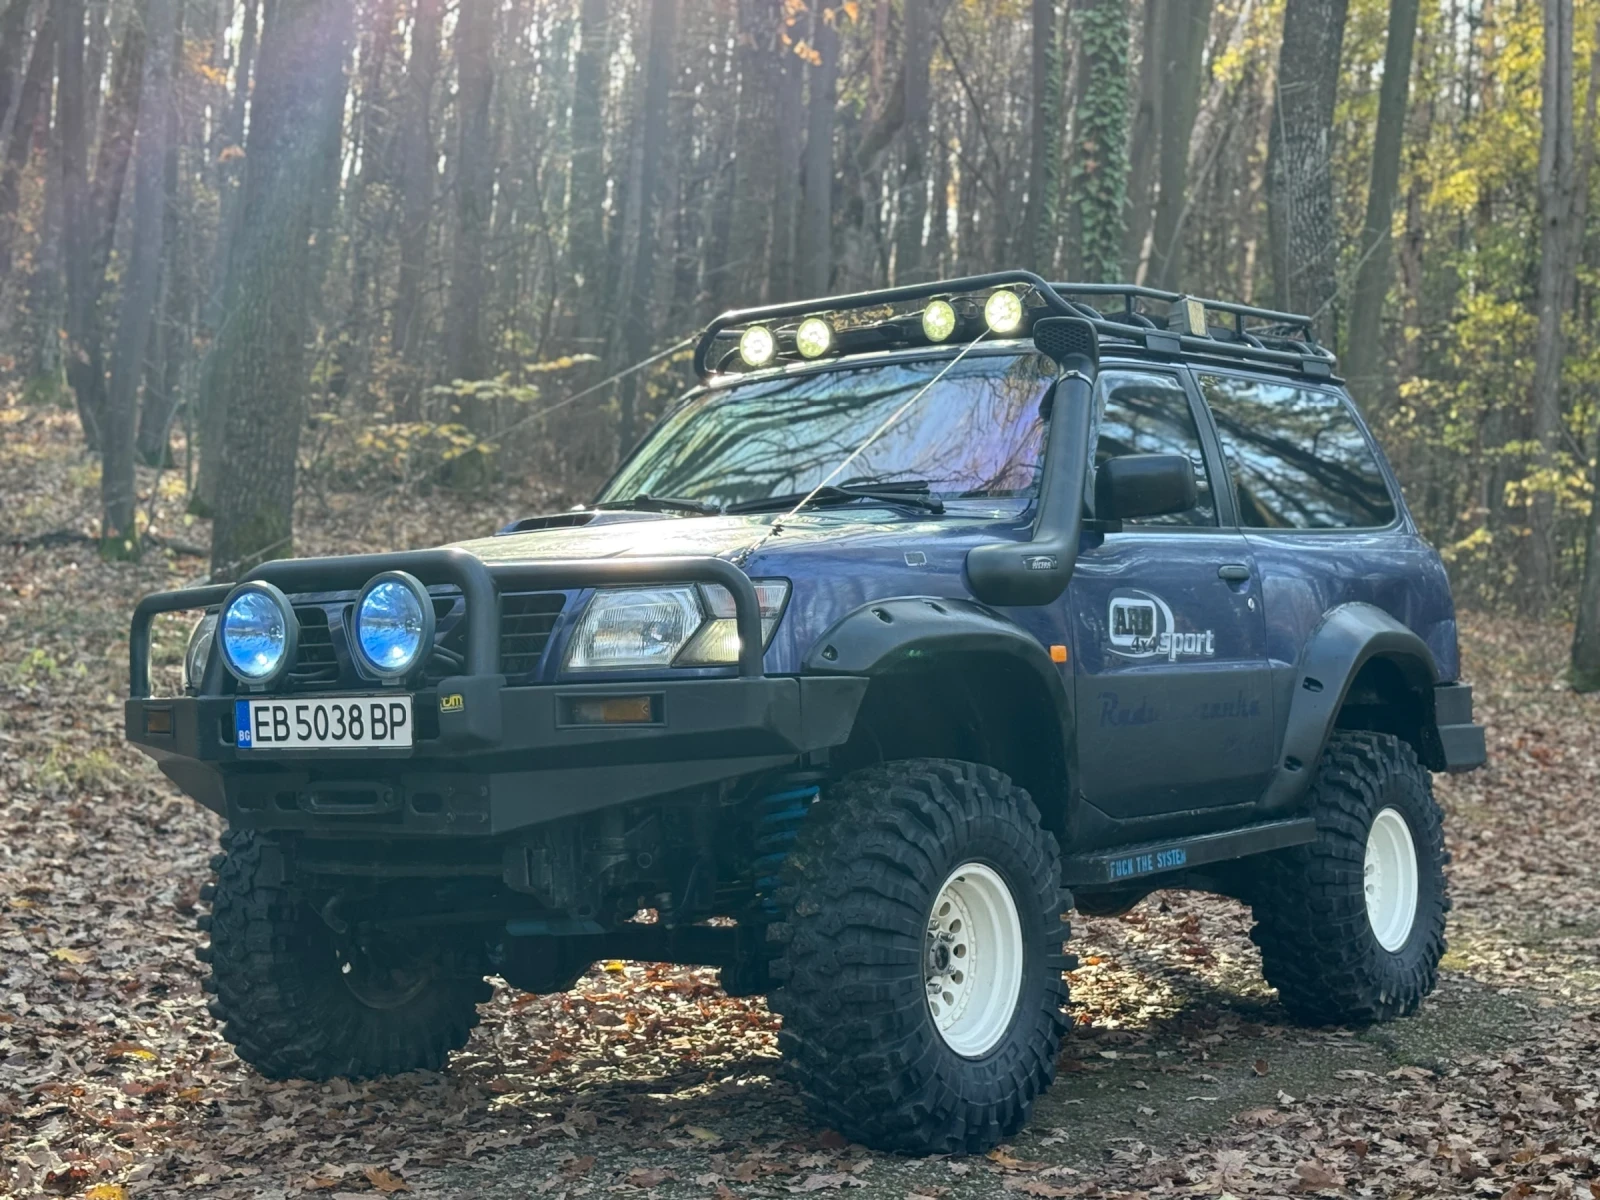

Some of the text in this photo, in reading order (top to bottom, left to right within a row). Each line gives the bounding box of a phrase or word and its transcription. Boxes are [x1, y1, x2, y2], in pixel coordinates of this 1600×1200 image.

[1131, 629, 1215, 662] 4x4 sport
[238, 730, 251, 742] BG
[254, 703, 407, 742] EB 5038 BP
[1109, 848, 1187, 878] FUCK THE SYSTEM
